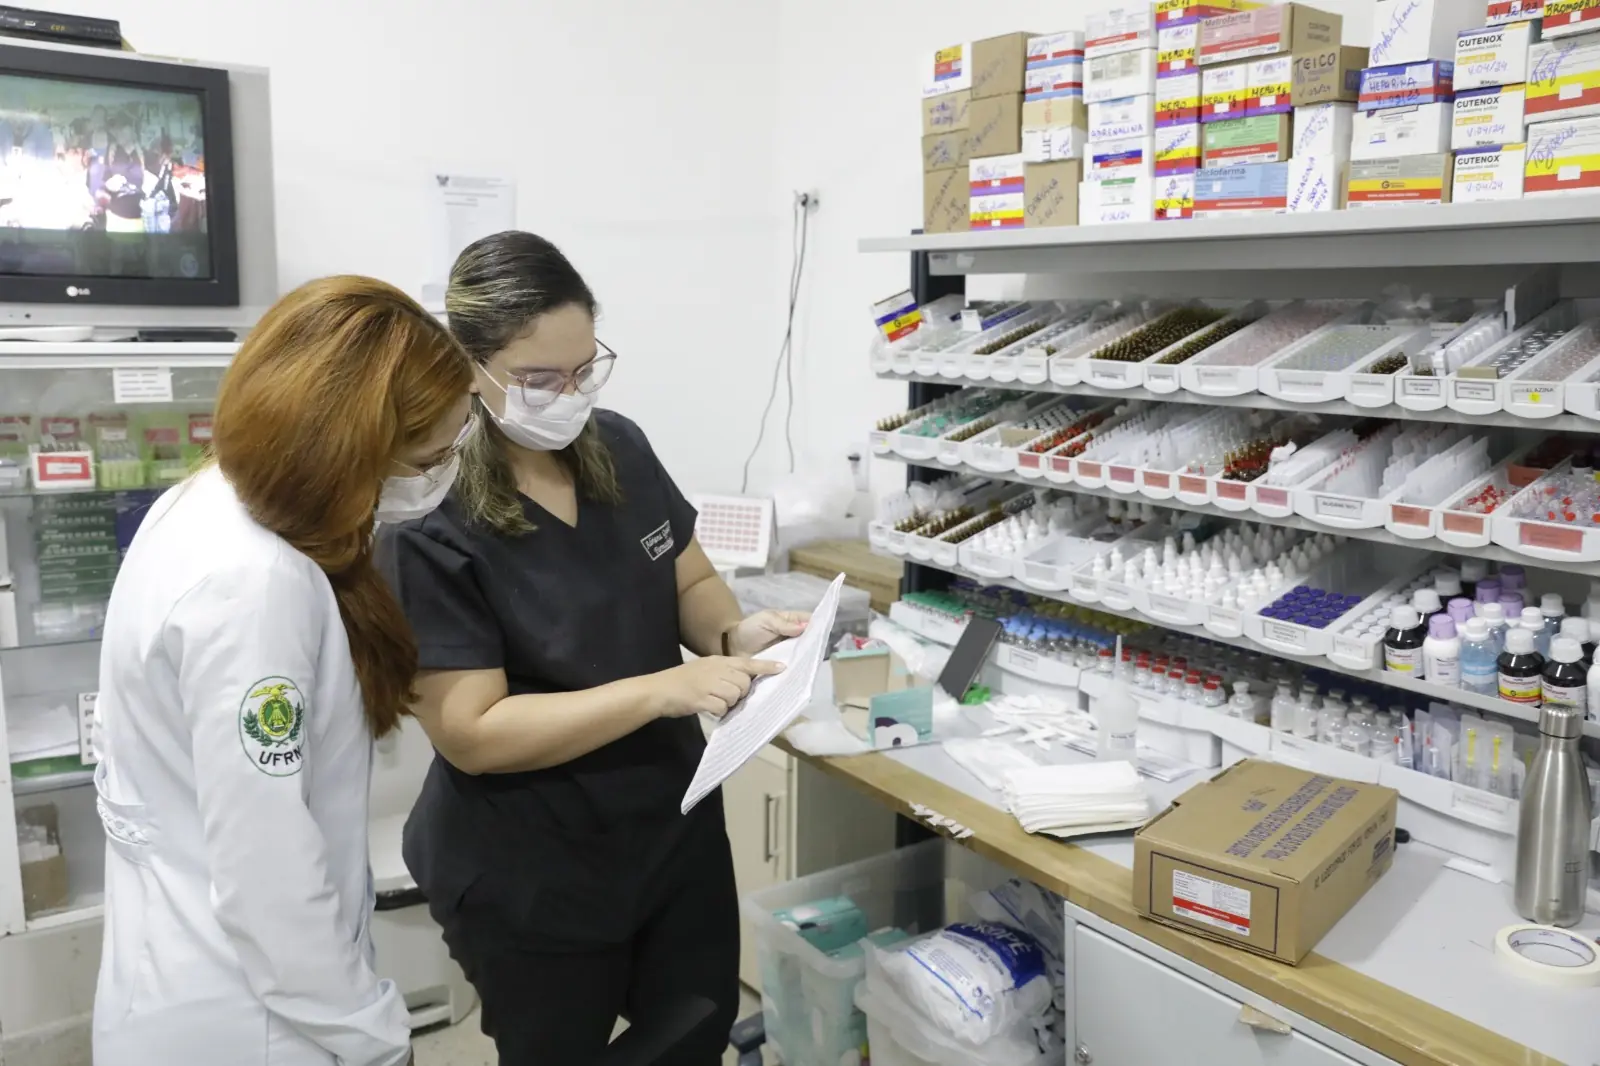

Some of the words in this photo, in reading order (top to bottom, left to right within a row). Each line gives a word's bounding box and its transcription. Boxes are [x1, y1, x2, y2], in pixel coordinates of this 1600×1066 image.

[1459, 33, 1503, 48] CUTENOX
[1294, 52, 1336, 71] TEICO
[1456, 96, 1500, 109] CUTENOX
[1457, 155, 1500, 166] CUTENOX
